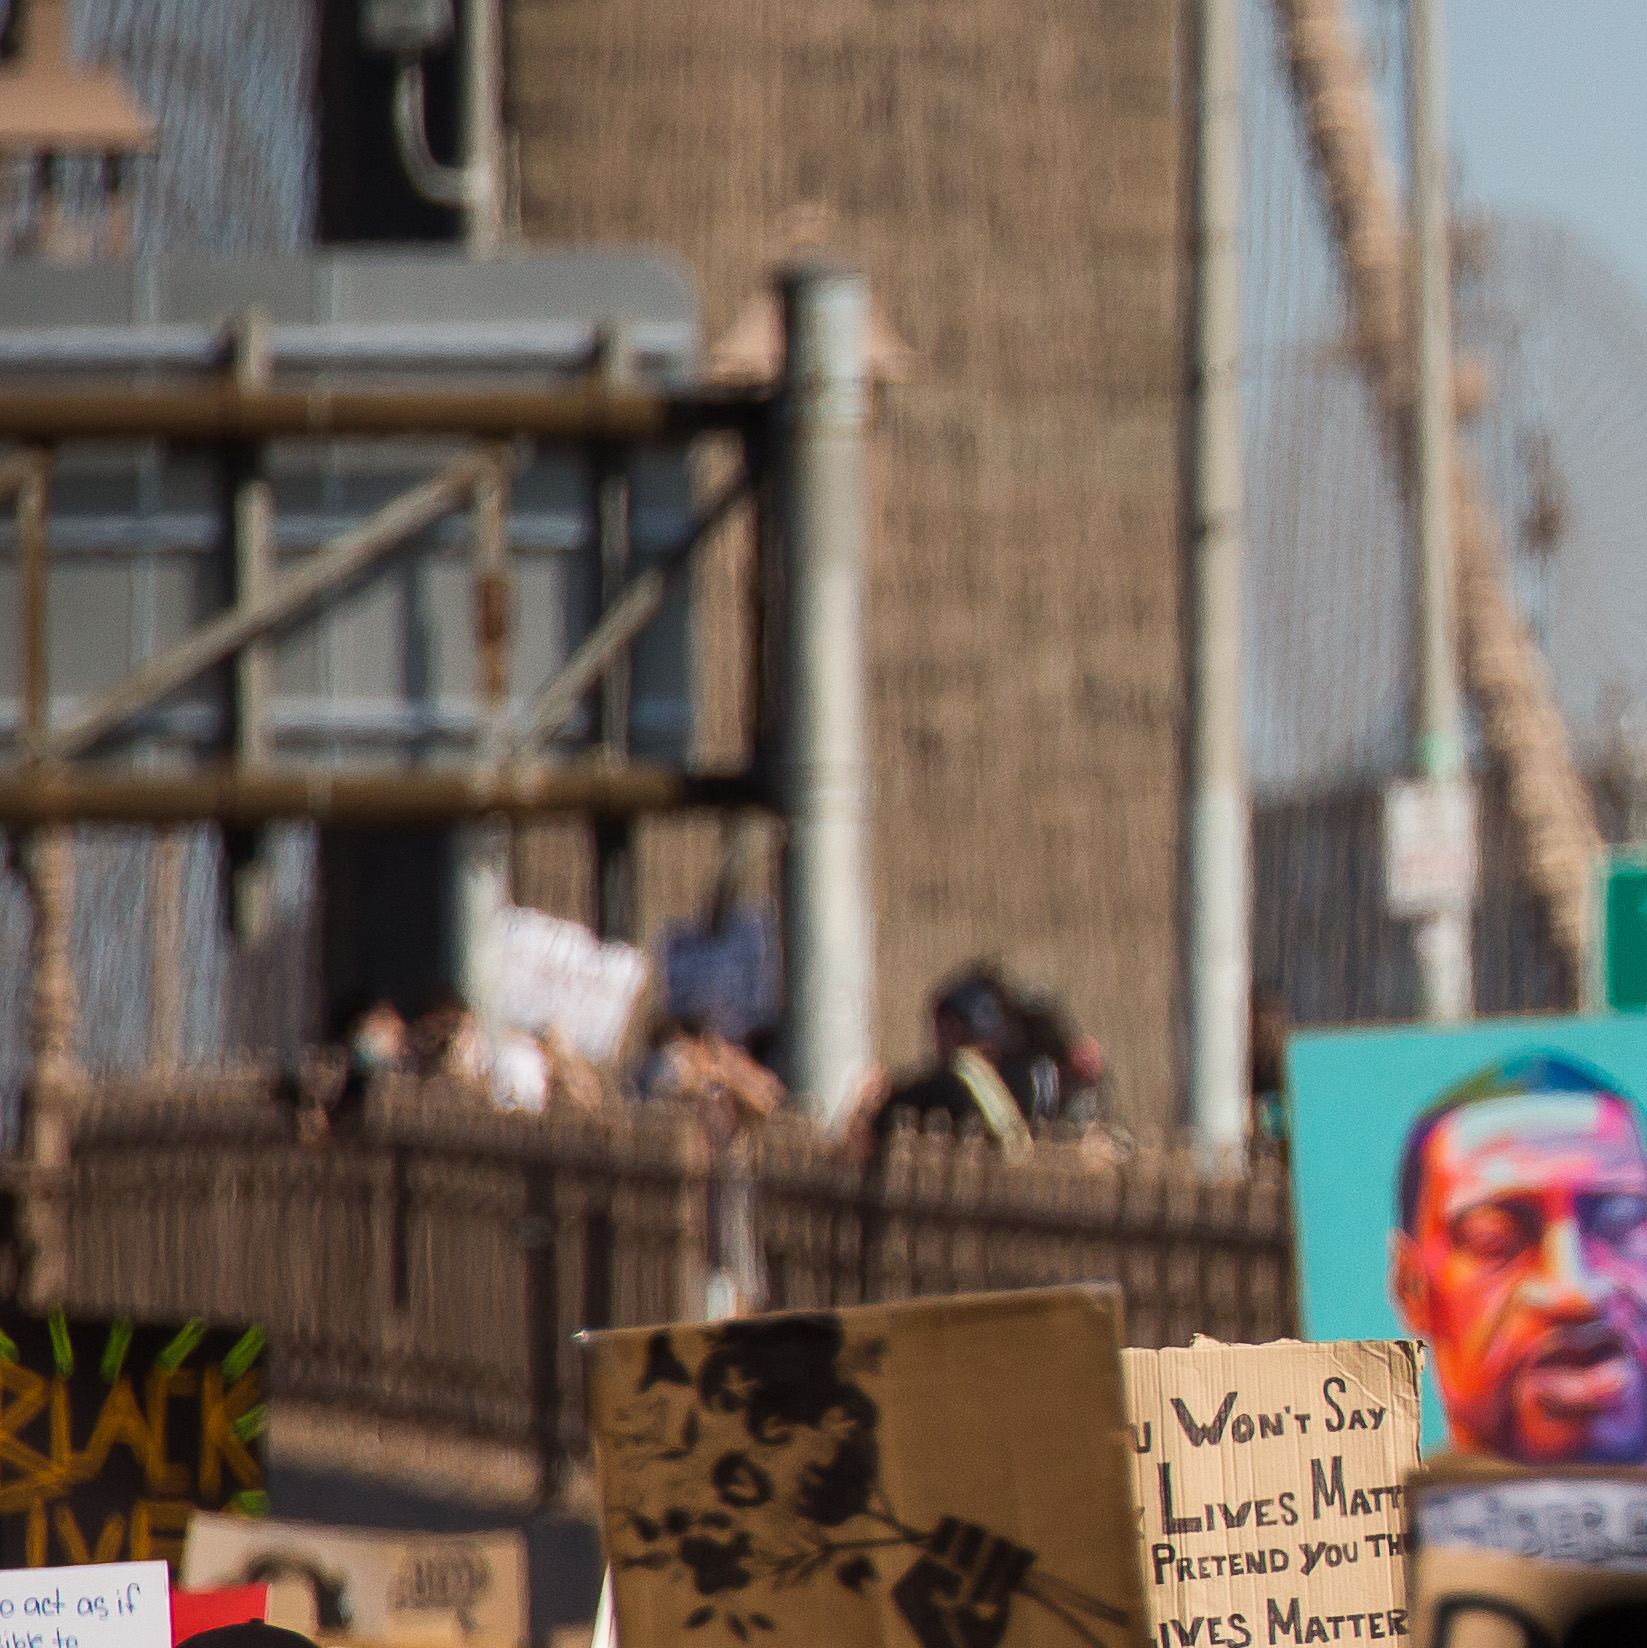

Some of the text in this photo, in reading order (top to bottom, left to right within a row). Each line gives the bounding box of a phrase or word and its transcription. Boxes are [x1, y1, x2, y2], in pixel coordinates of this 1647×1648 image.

[24, 1587, 65, 1616] act
[77, 1596, 109, 1620] as
[116, 1582, 141, 1616] if
